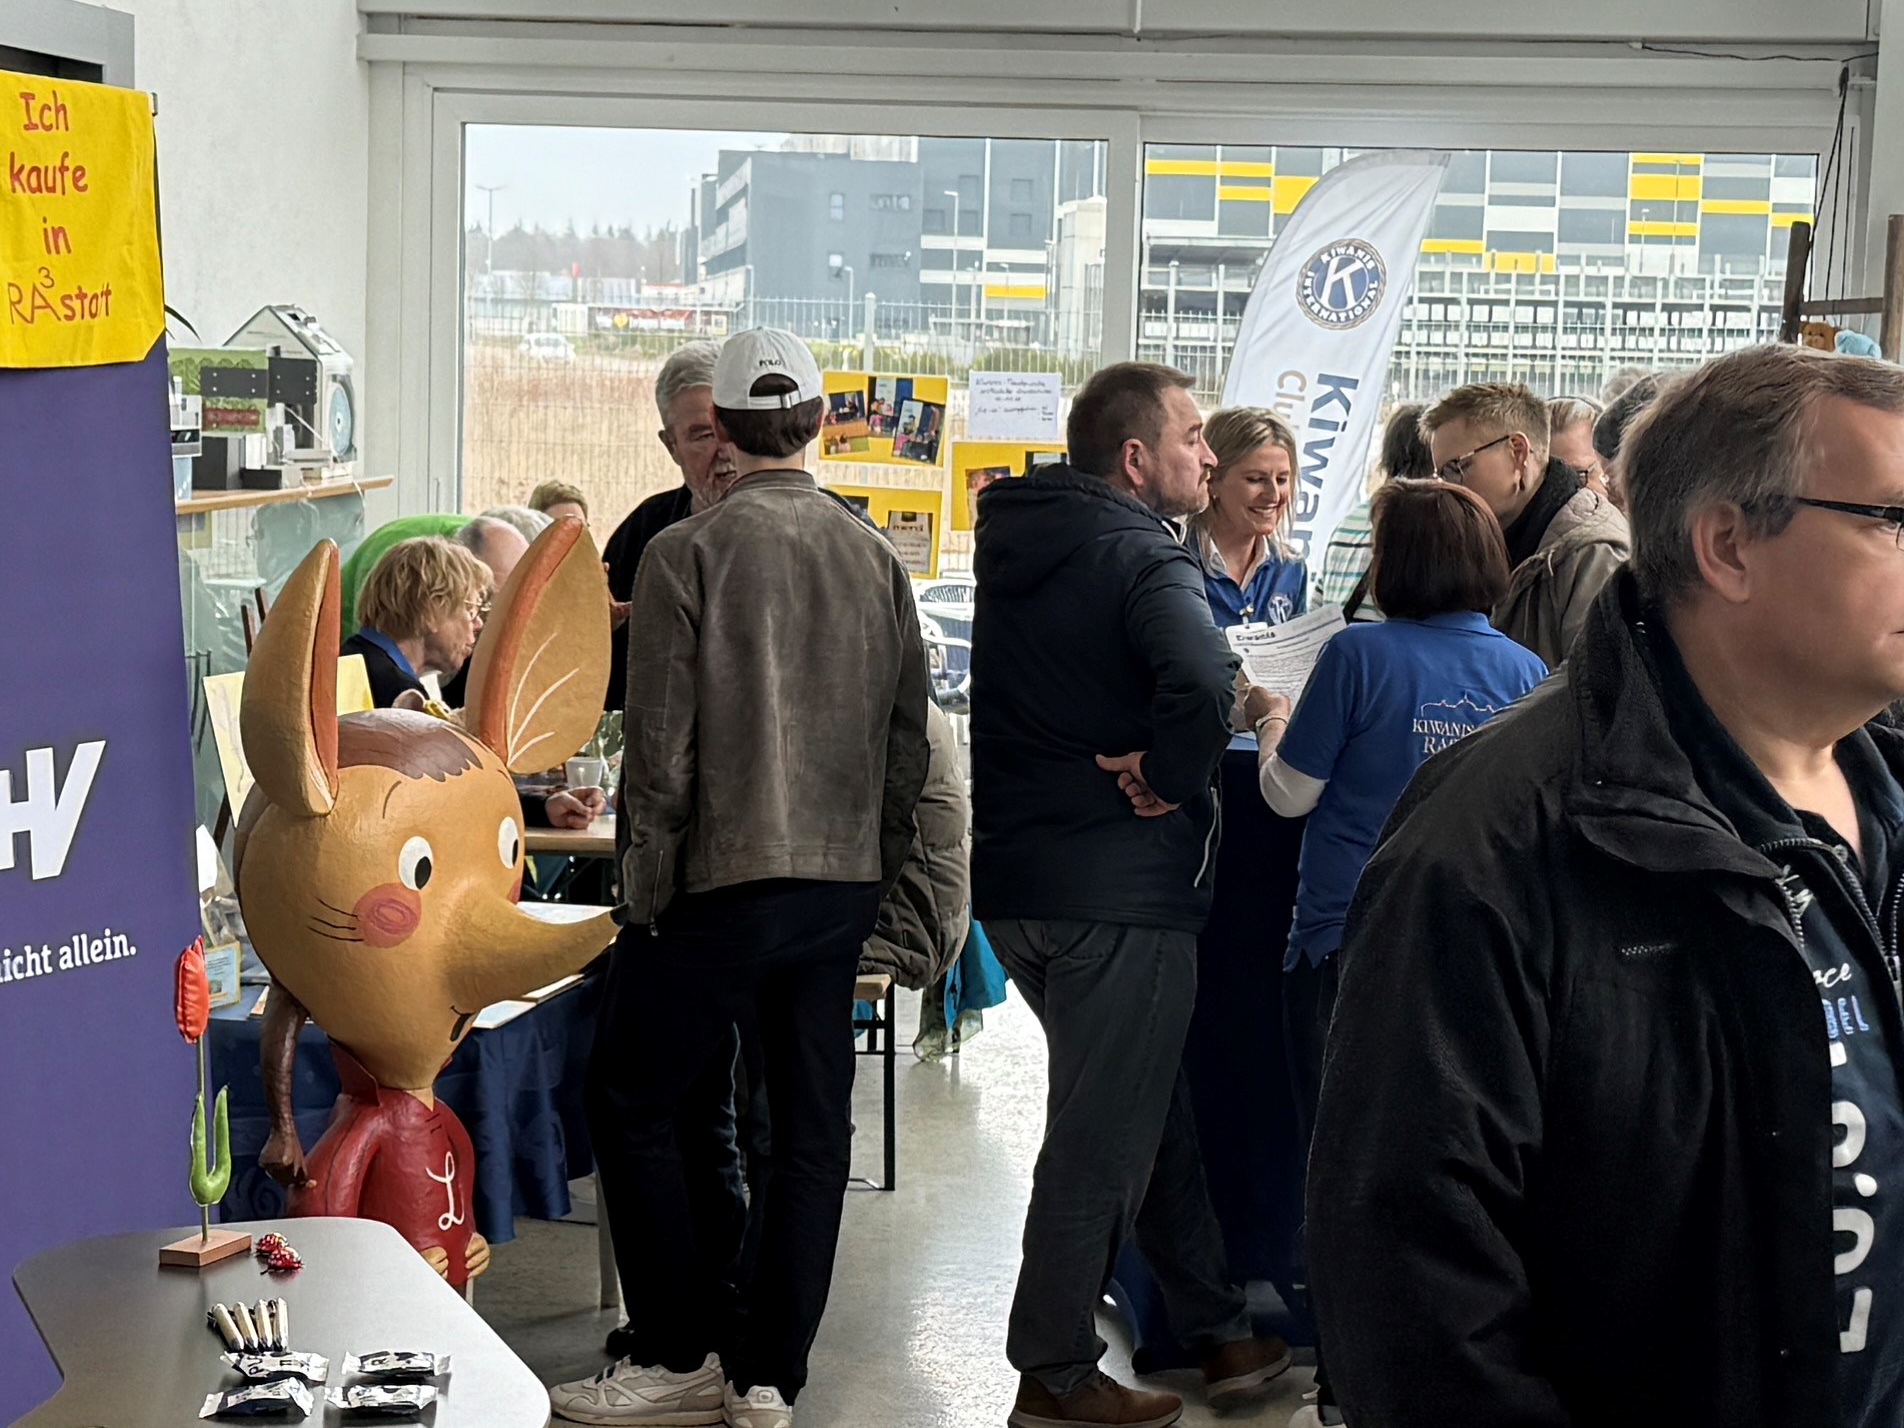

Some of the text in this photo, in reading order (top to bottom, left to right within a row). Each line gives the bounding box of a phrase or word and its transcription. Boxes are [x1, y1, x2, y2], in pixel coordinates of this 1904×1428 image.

[19, 90, 70, 132] Ich
[9, 150, 89, 196] kaufe
[42, 216, 72, 255] in
[1320, 245, 1376, 270] KIWANIS
[1303, 270, 1379, 323] INTERNATIONAL
[1274, 369, 1308, 430] Clu
[58, 928, 137, 970] allein.
